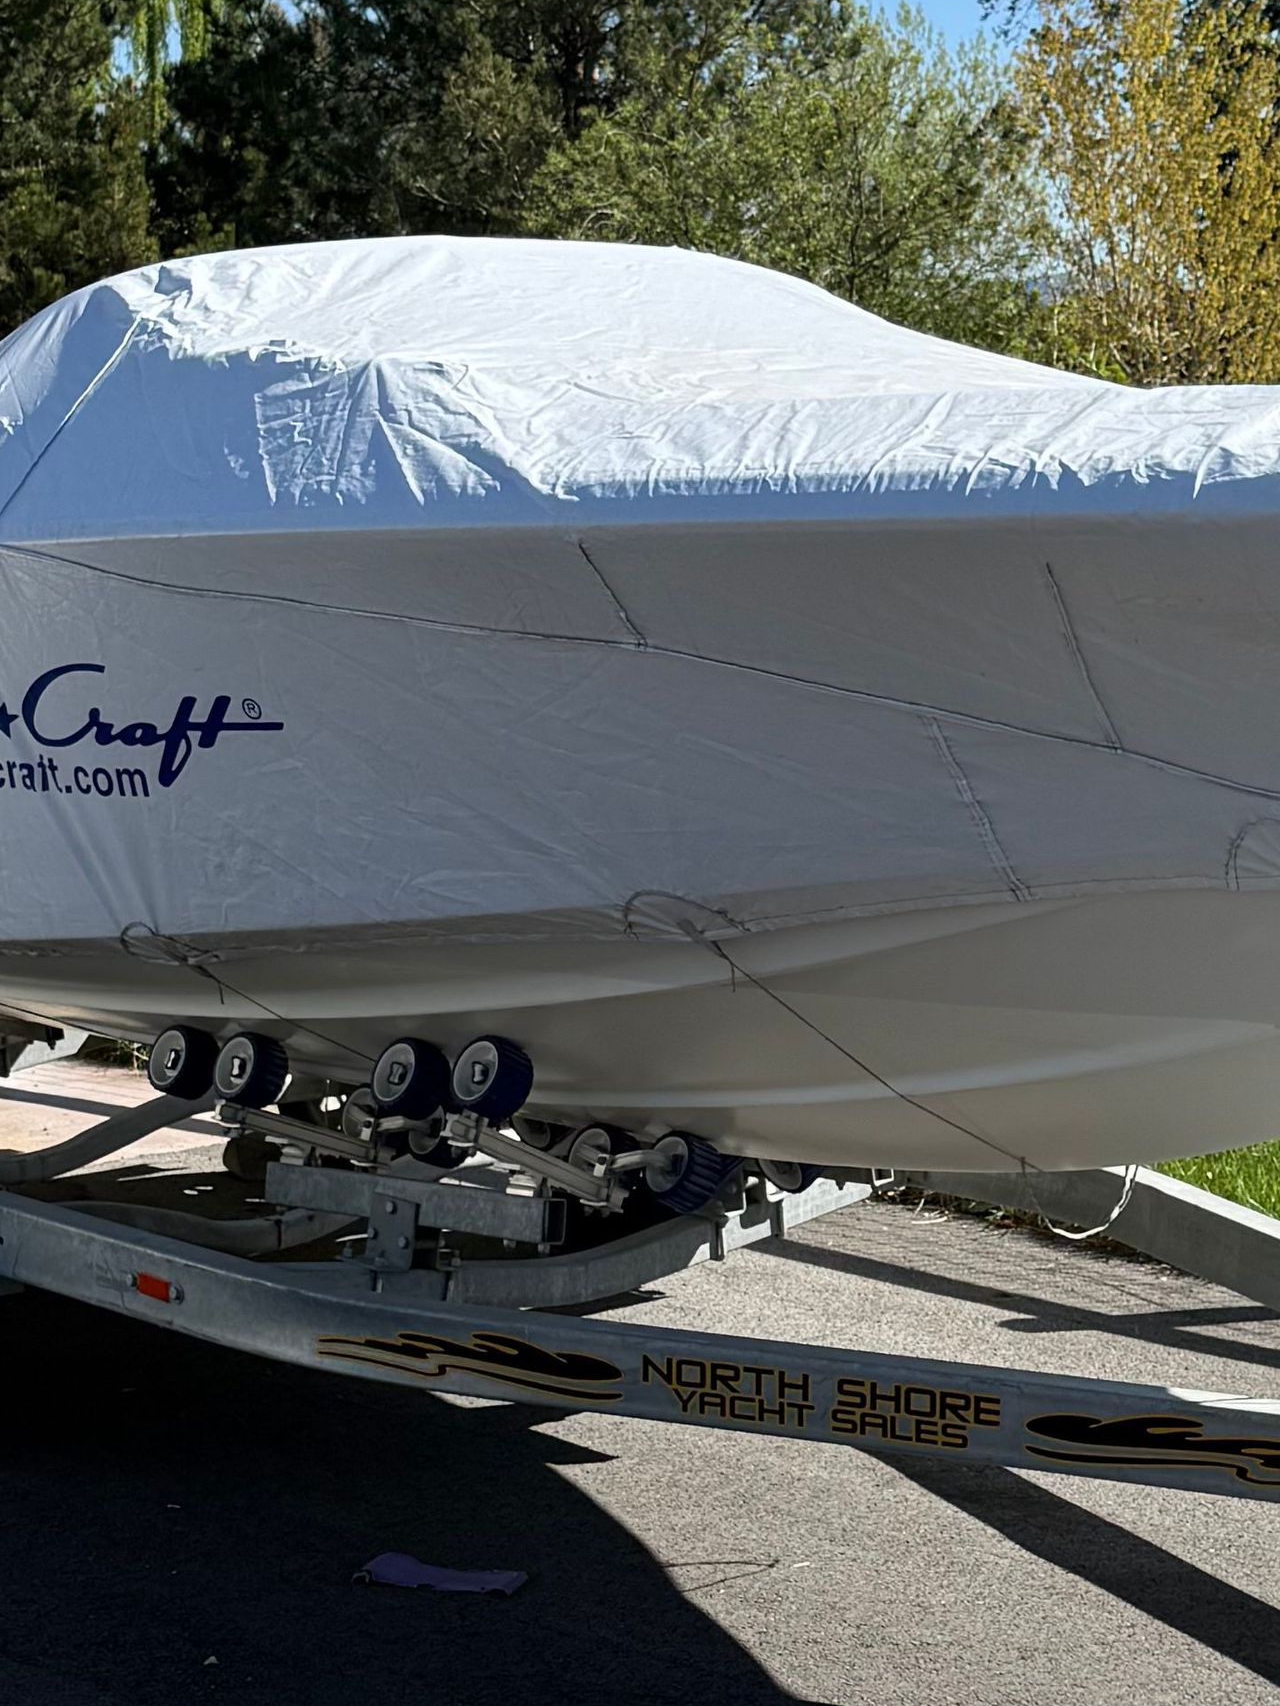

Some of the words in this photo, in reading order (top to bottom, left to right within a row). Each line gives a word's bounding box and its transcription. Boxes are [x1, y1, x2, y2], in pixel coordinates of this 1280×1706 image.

[642, 1354, 810, 1401] NORTH
[836, 1378, 1001, 1426] SHORE
[672, 1389, 815, 1427] YACHT
[831, 1409, 969, 1448] SALES
